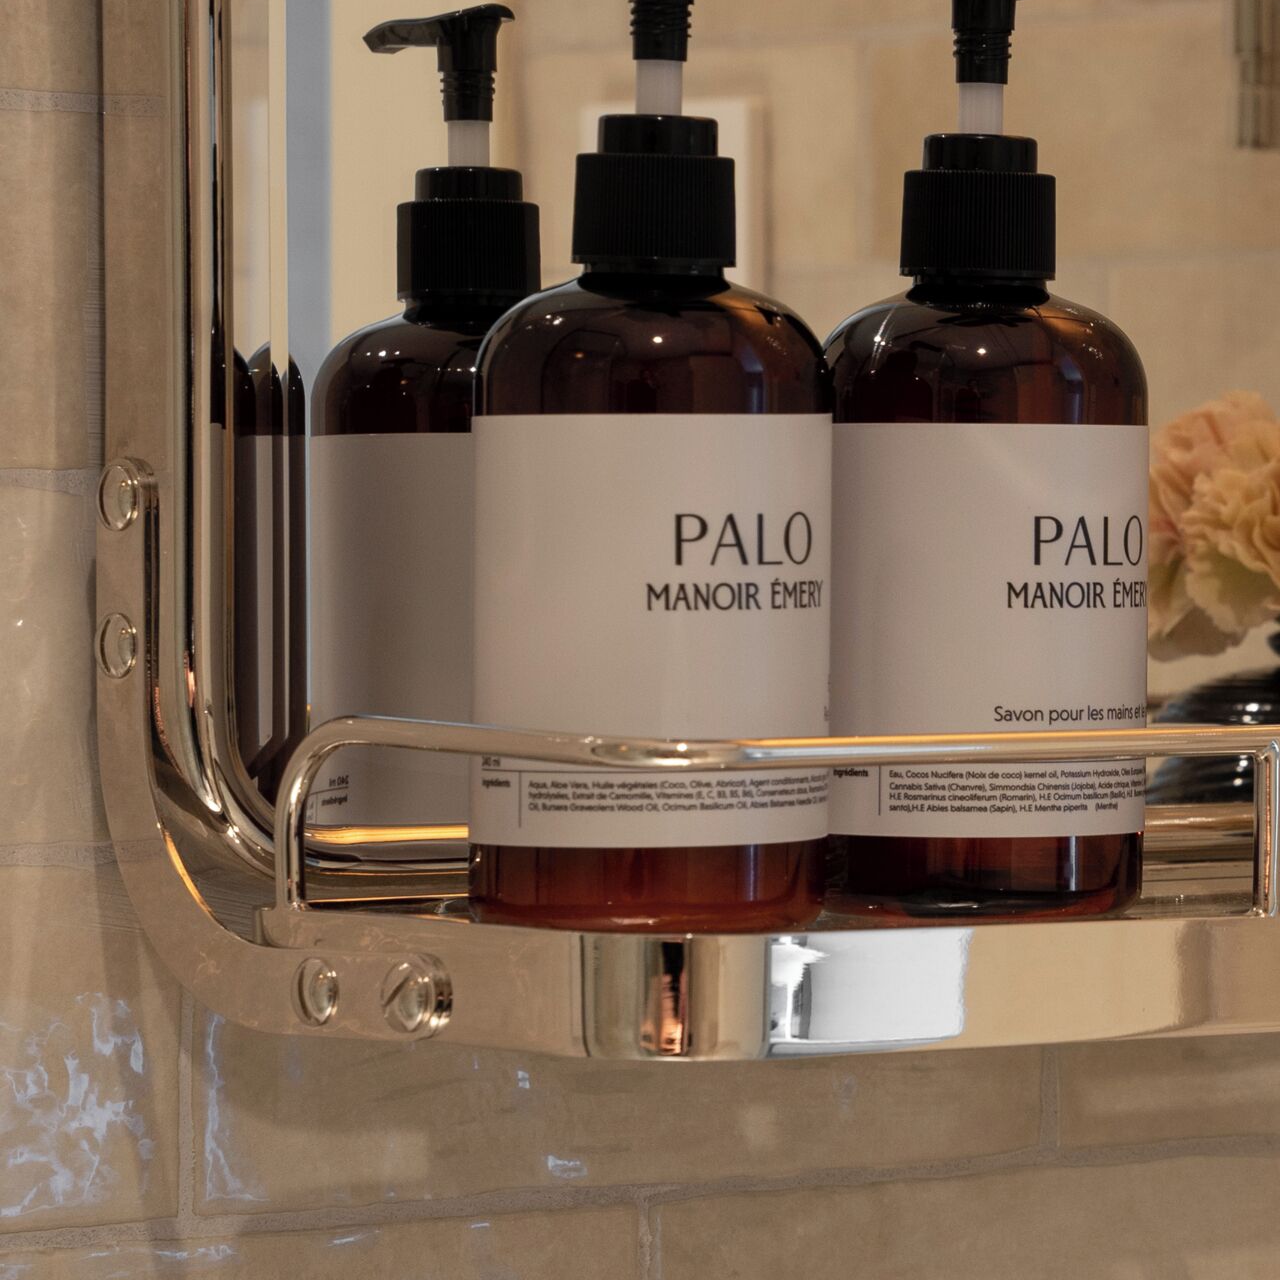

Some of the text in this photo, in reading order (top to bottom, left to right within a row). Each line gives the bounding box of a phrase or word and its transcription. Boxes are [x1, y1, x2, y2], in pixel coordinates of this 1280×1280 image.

[674, 511, 812, 566] PALO
[1033, 515, 1143, 566] PALO
[646, 578, 823, 611] MANOIR ÉMERY
[1007, 582, 1106, 608] MANOIR
[994, 706, 1044, 722] Savon
[1049, 708, 1084, 725] pour
[1087, 705, 1104, 720] les
[1107, 704, 1133, 720] mains
[1134, 704, 1141, 719] et
[889, 770, 904, 779] Eau,
[906, 770, 929, 779] Cocos
[931, 770, 964, 779] Nucifera
[965, 771, 987, 781] (Noix
[988, 771, 999, 780] de
[1001, 771, 1022, 781] coco)
[1024, 771, 1047, 780] kernel
[1048, 770, 1059, 780] oil,
[1061, 769, 1092, 778] Potassium
[550, 780, 568, 789] Aloe
[889, 782, 922, 791] Cannabis
[924, 782, 946, 791] Sativa
[947, 782, 987, 793] (Chanvre),
[989, 782, 1036, 792] Simmondsia
[1037, 782, 1070, 791] Chinensis
[889, 792, 902, 801] H.E
[903, 792, 946, 801] Rosmarinus
[999, 793, 1037, 804] (Romarin),
[1039, 792, 1051, 801] H.E
[1053, 792, 1082, 801] Ocimum
[1083, 791, 1108, 800] basilicum
[926, 803, 948, 812] Abies
[950, 803, 988, 813] balsamea
[989, 803, 1017, 814] (Sapin),
[1019, 803, 1032, 812] H.E
[1034, 803, 1061, 812] Mentha
[1063, 803, 1088, 813] piperita
